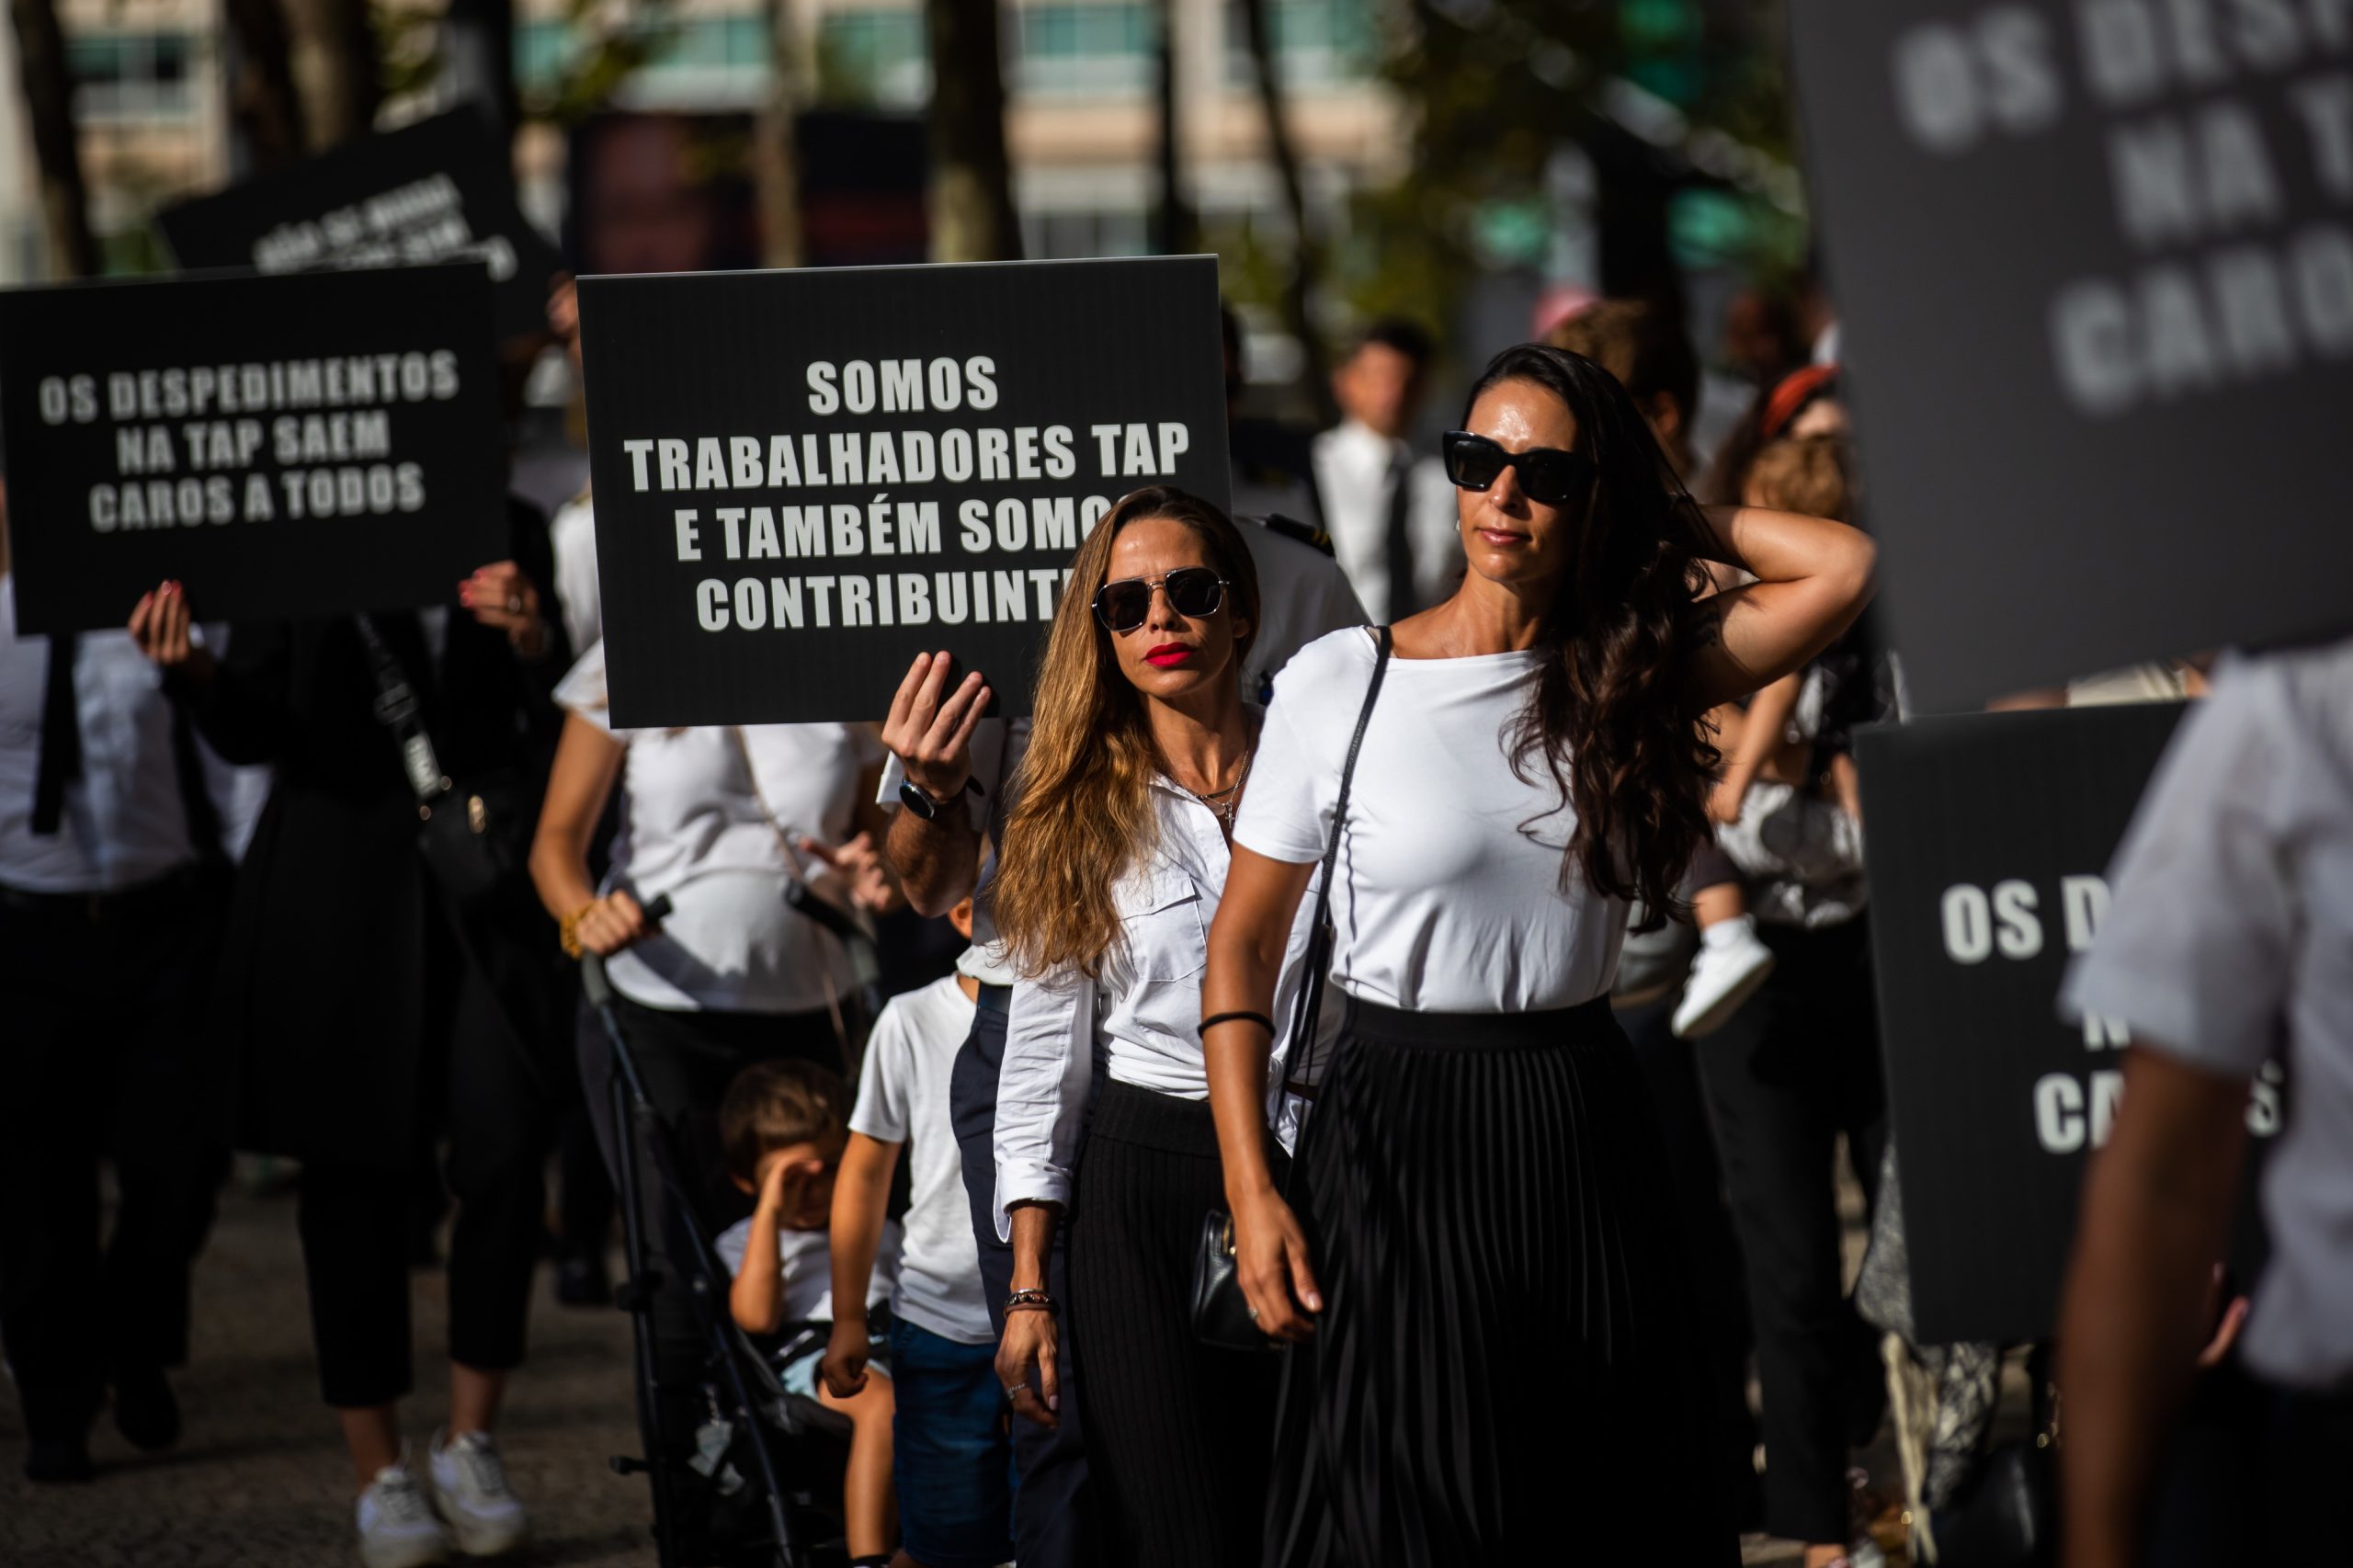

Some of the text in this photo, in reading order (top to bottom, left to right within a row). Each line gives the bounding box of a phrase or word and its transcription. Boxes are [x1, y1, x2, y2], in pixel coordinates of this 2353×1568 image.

[40, 349, 459, 424] OS DESPEDIMENTOS
[805, 355, 999, 415] SOMOS
[117, 410, 391, 474] NA TAP SAEM
[623, 422, 1190, 493] TRABALHADORES TAP
[89, 461, 426, 532] CAROS A TODOS
[674, 492, 1129, 562] E TAMBÉM SOMO
[695, 567, 1074, 632] CONTRIBUINT
[1940, 879, 2045, 964] OS
